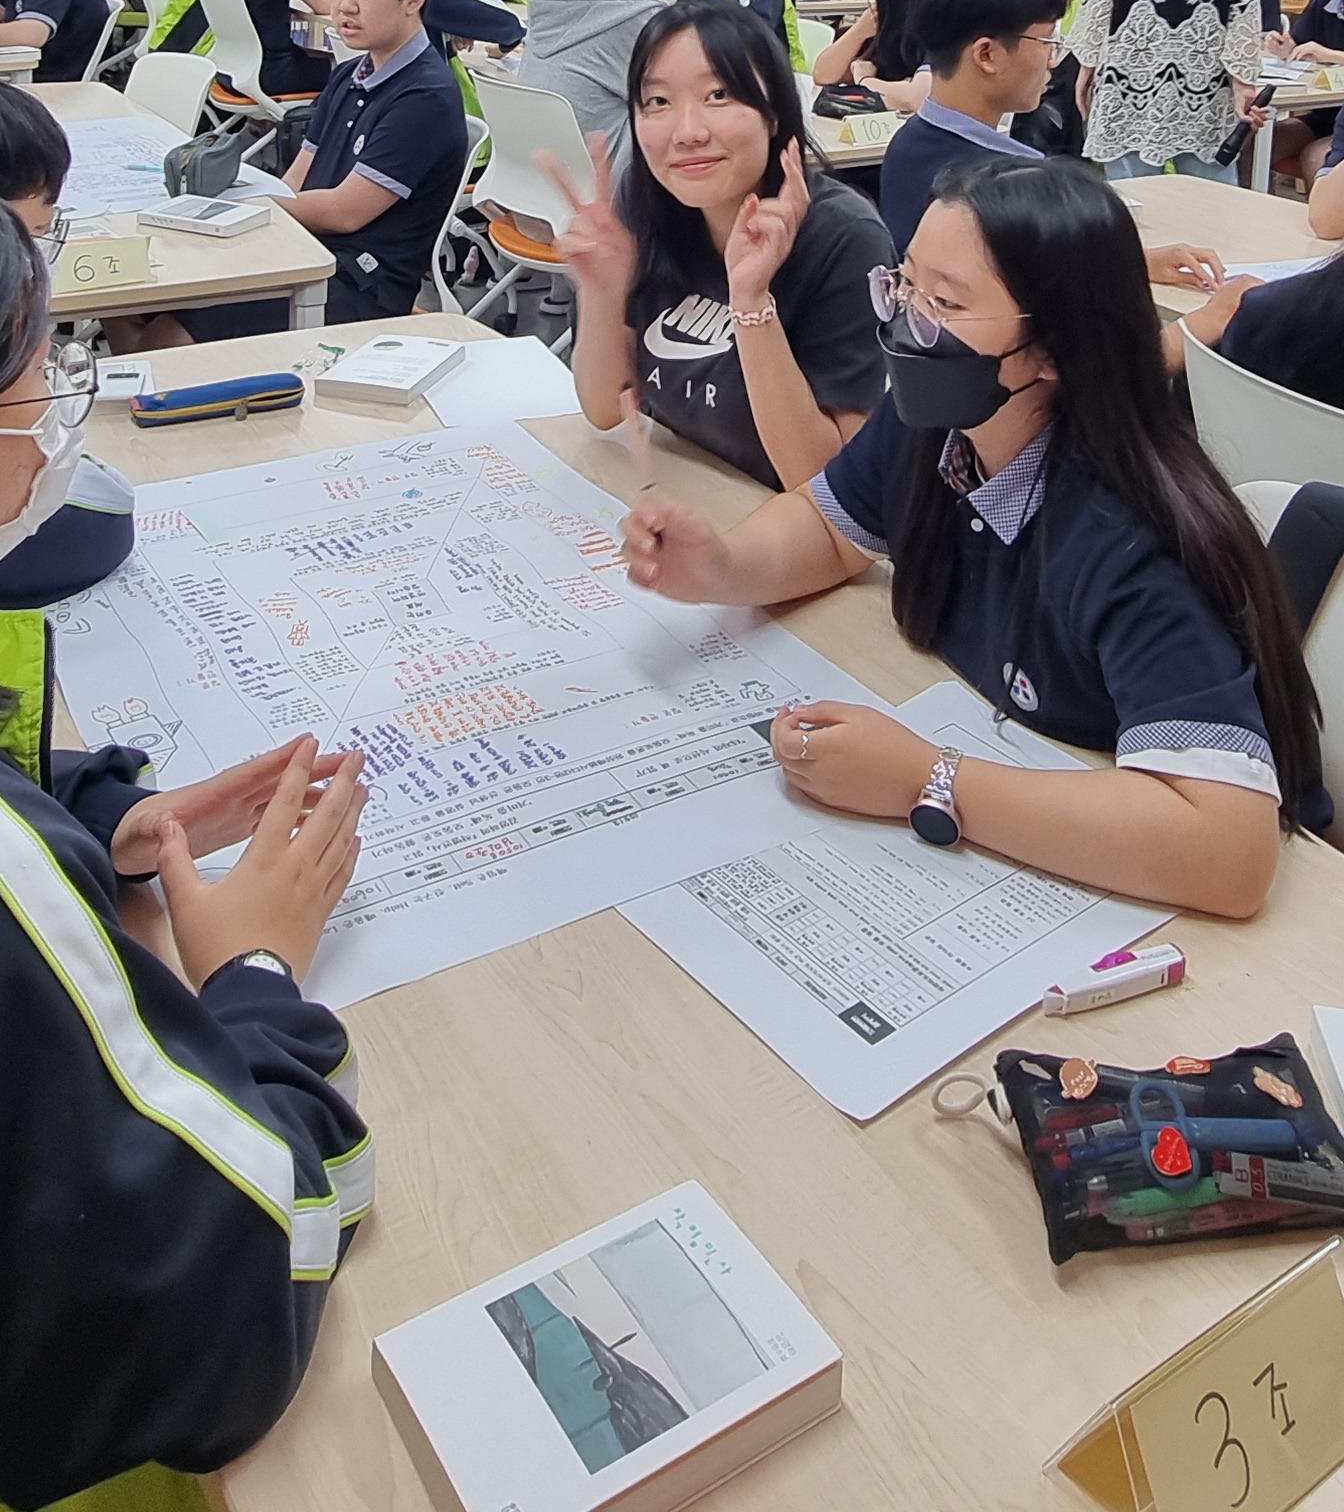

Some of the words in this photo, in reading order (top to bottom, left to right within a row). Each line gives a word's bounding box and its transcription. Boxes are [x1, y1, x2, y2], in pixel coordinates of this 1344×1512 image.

[72, 254, 122, 283] 6조
[646, 366, 719, 409] AIR
[1193, 1361, 1299, 1509] 3조
